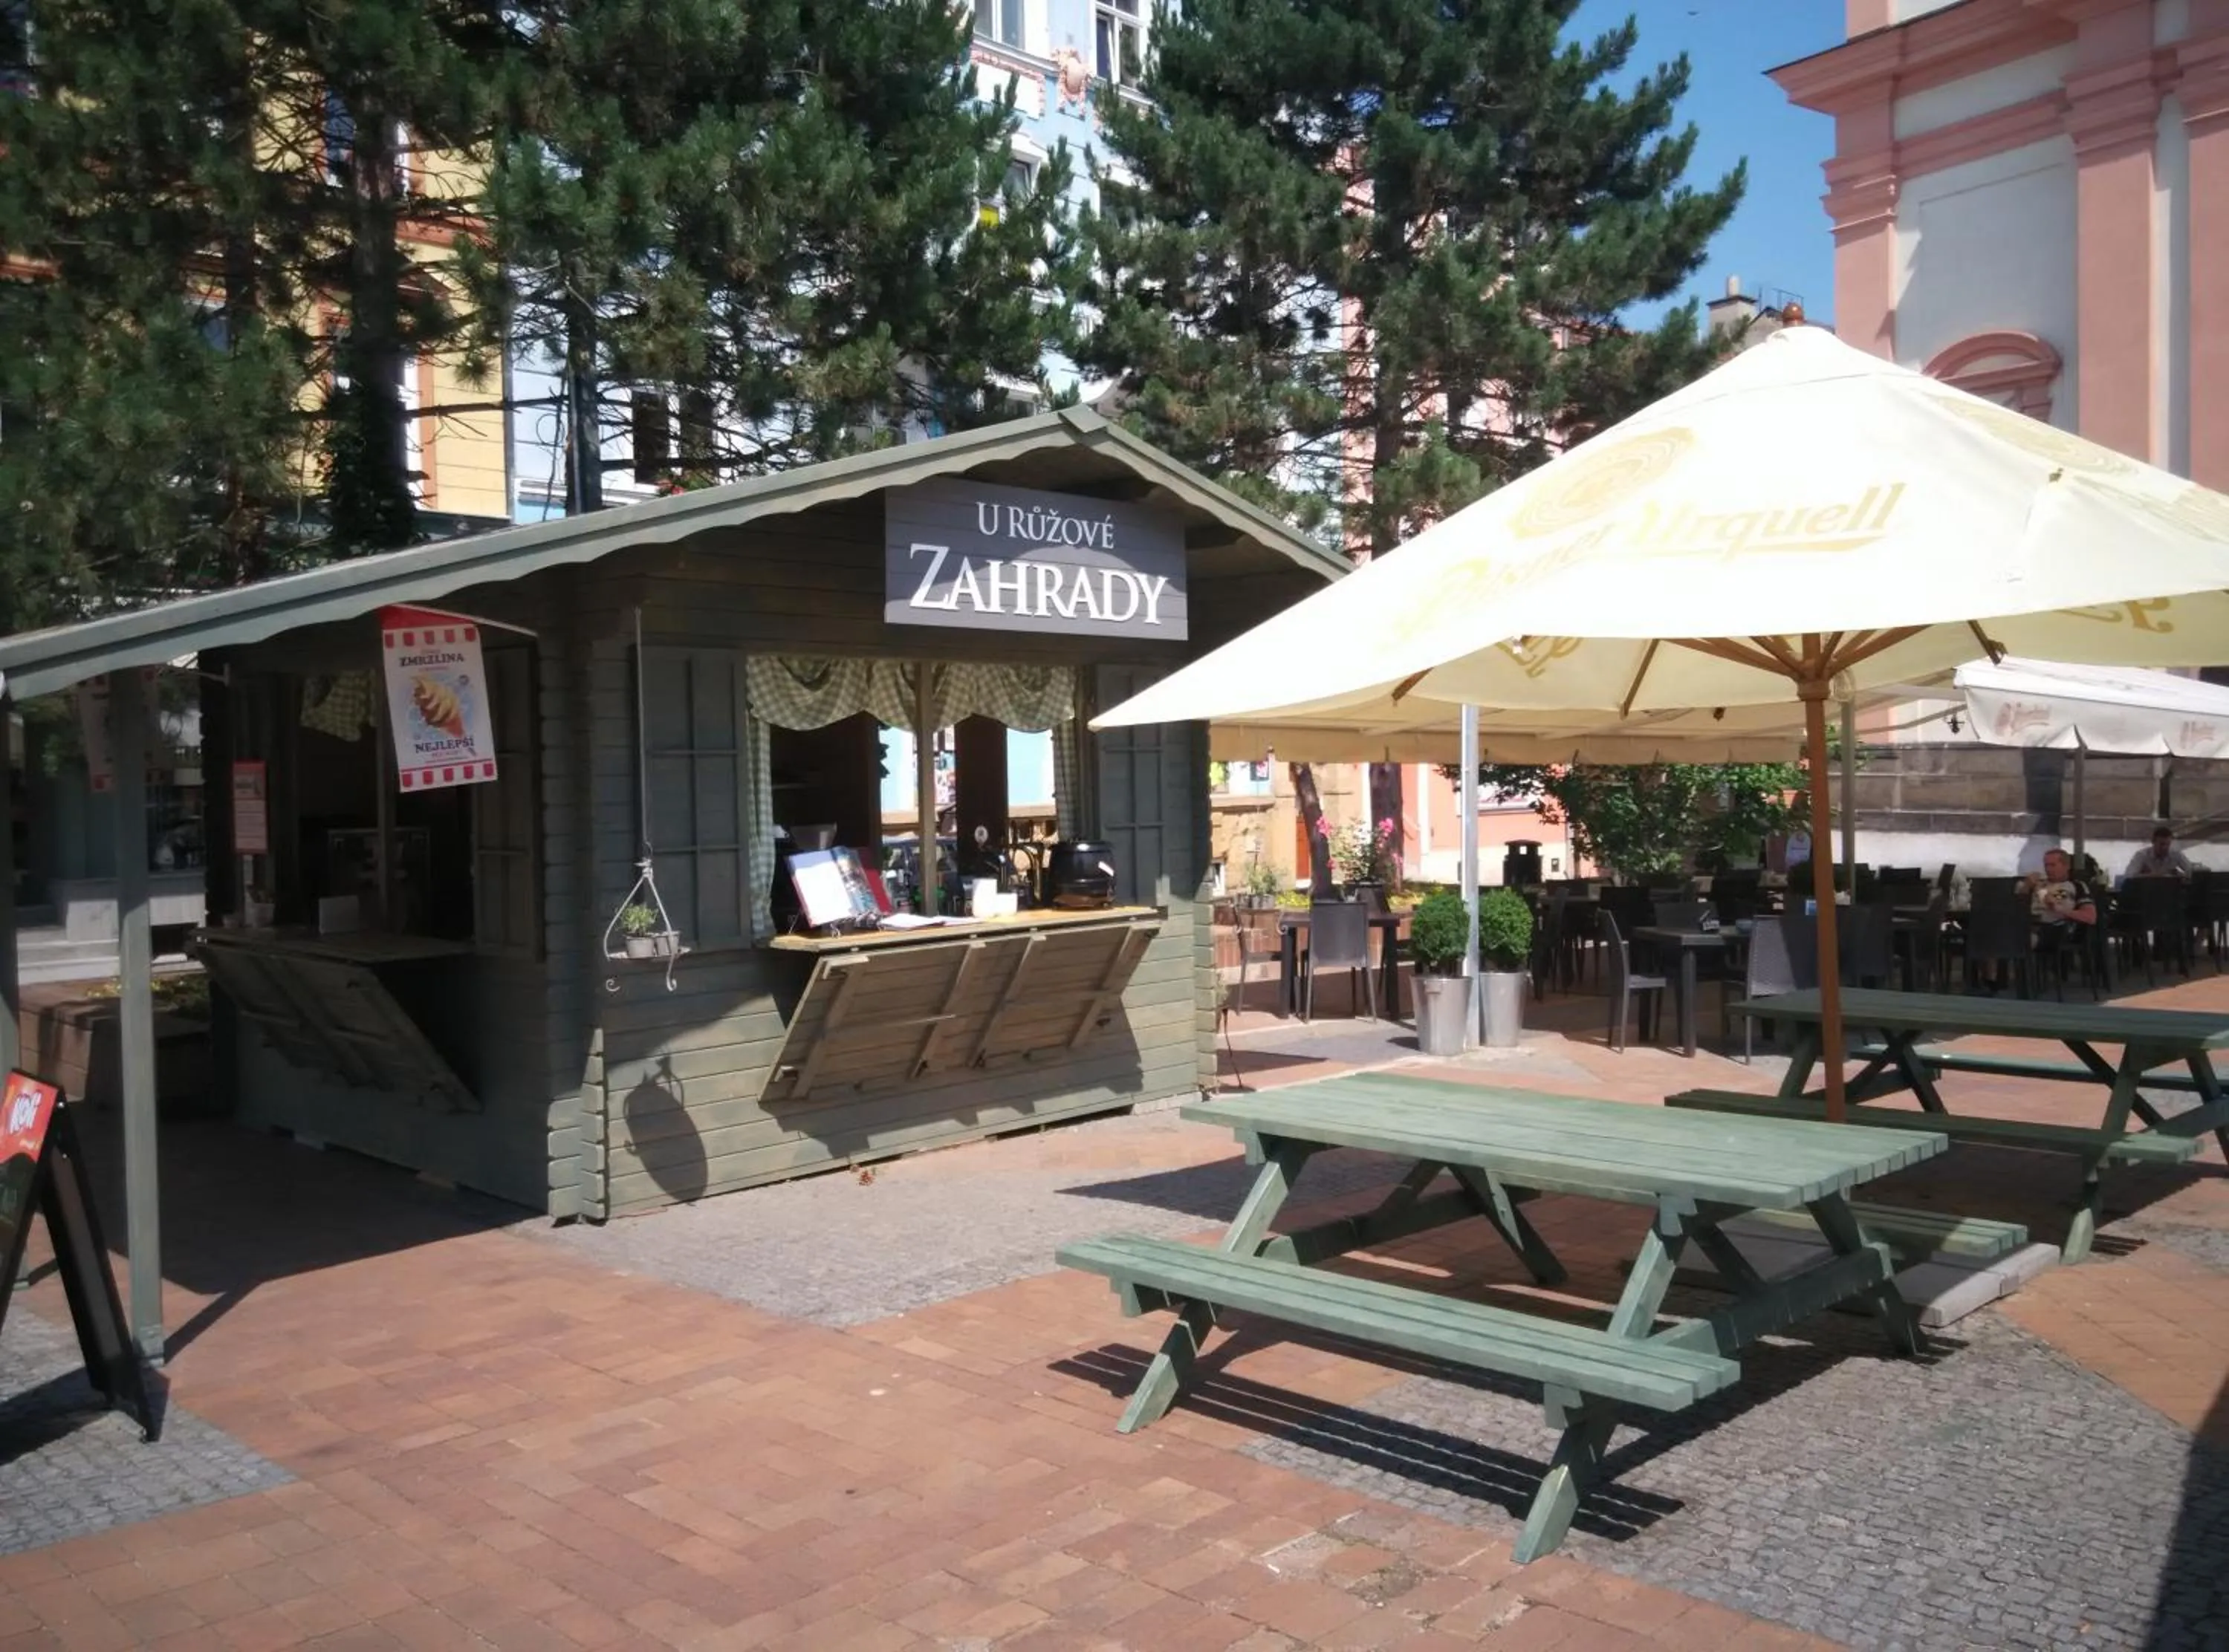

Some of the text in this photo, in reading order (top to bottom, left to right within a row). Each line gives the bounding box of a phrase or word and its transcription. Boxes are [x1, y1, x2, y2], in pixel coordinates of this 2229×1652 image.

[976, 502, 1114, 549] U RŮŽOVÉ
[1630, 482, 1907, 562] Urquell
[909, 543, 1169, 625] ZAHRADY
[400, 653, 464, 667] ZMRZLINA
